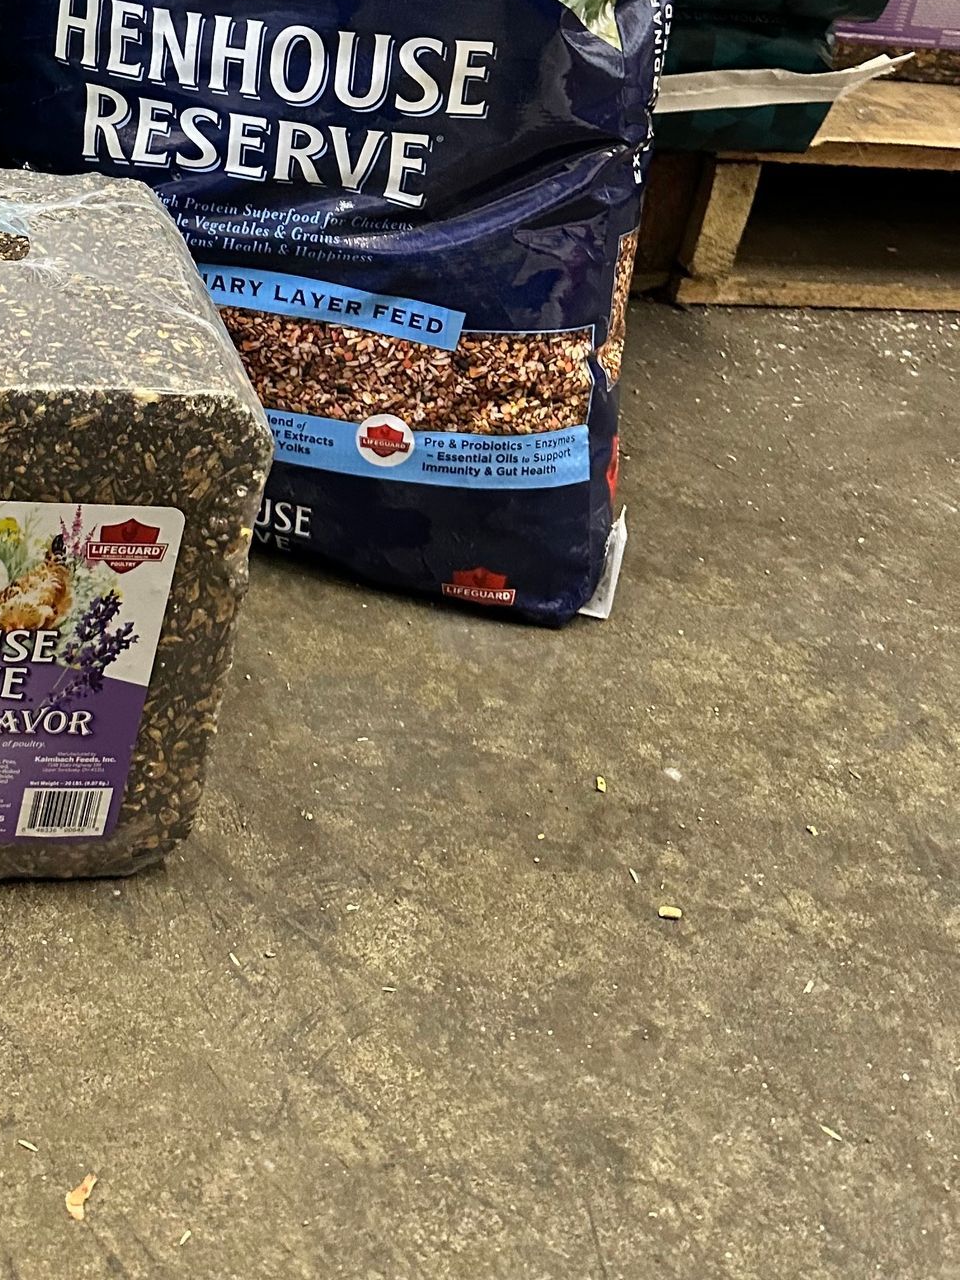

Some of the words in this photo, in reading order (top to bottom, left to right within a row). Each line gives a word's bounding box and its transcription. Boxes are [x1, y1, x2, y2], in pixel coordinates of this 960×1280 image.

[82, 84, 434, 209] RESERVE
[184, 197, 239, 216] Protein
[242, 204, 319, 225] Superfood
[321, 211, 345, 229] for
[350, 216, 415, 232] Chickens
[194, 214, 270, 238] Vegetables
[290, 227, 340, 245] Grains
[221, 237, 273, 255] Health
[294, 244, 374, 263] Happiness
[273, 284, 362, 316] LAYER
[372, 303, 444, 334] FEED
[279, 440, 312, 455] Yolks
[283, 430, 335, 448] Extracts
[362, 437, 407, 451] LIFEGUARD
[424, 437, 446, 451] Pre
[460, 438, 523, 452] Probiotics
[534, 433, 576, 450] Enzymes
[436, 450, 492, 464] Essential
[495, 451, 519, 464] Oils
[532, 447, 572, 465] Support
[421, 462, 481, 478] Immunity
[495, 465, 519, 477] Gut
[521, 462, 557, 477] Health
[91, 544, 161, 557] LIFEGUARD
[445, 584, 513, 602] LIFEGUARD
[34, 755, 75, 763] Kalmbach
